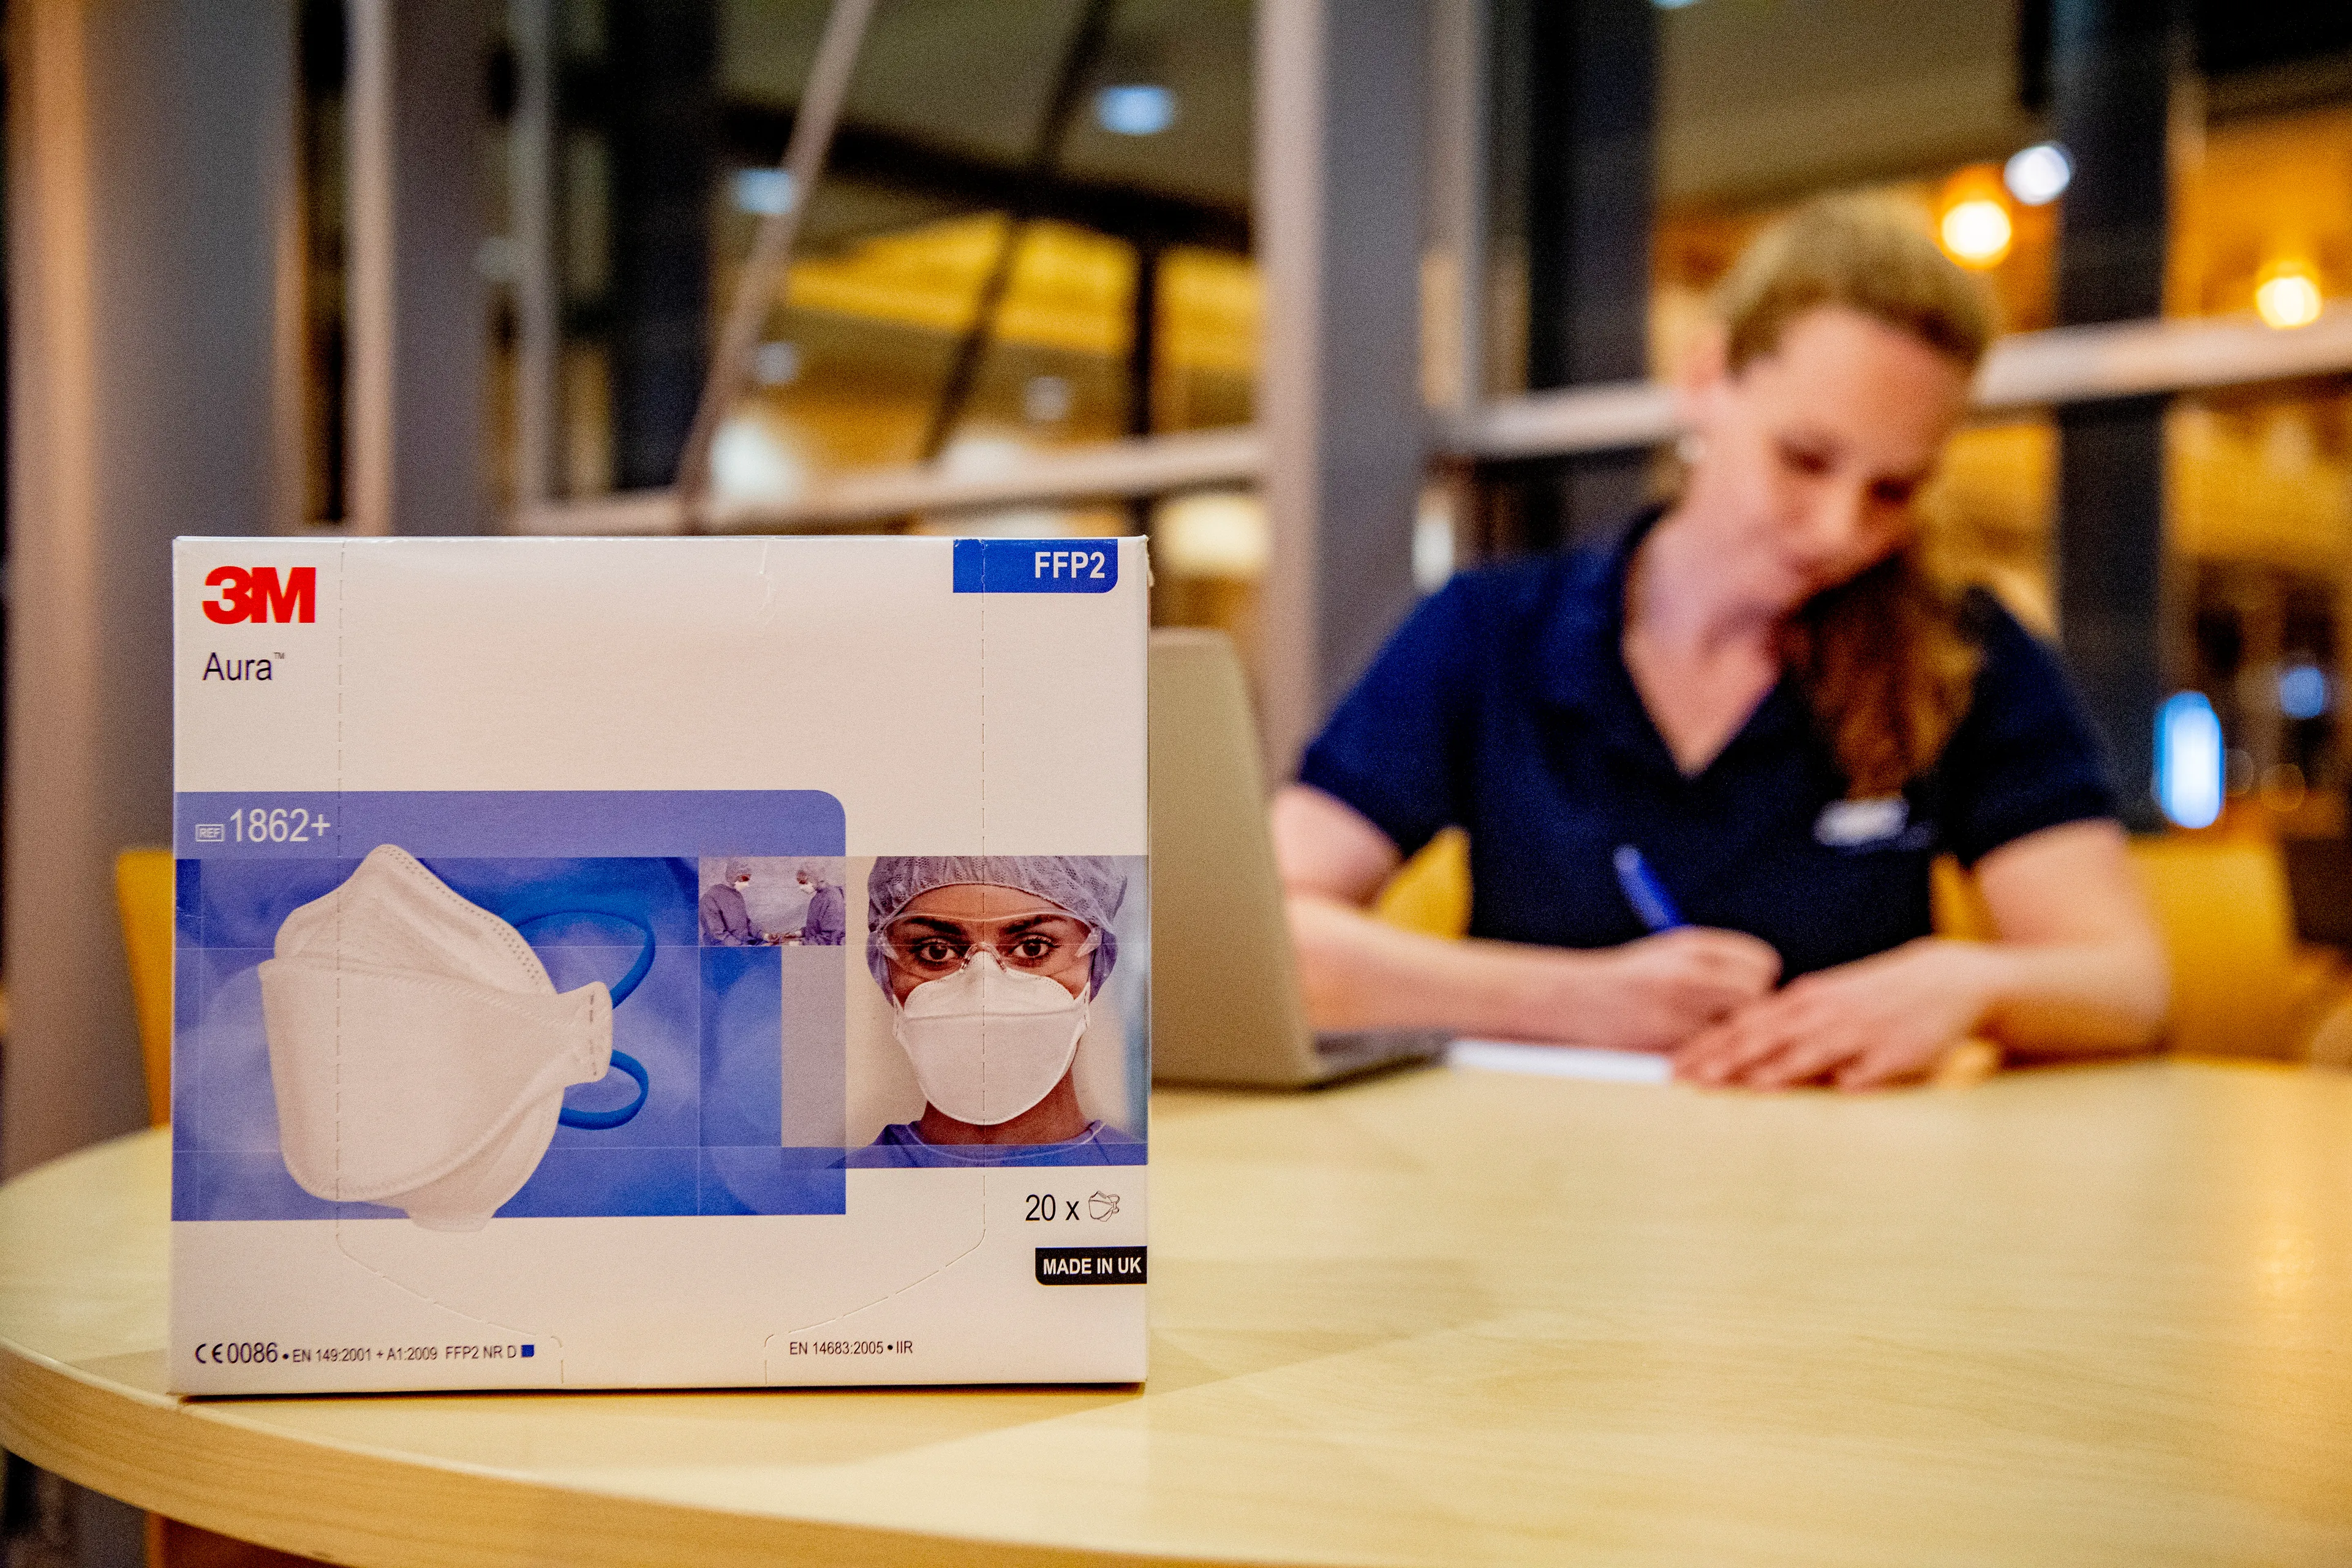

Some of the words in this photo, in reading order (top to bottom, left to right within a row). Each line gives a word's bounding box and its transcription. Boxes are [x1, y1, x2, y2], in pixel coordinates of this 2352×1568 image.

[1035, 552, 1106, 579] FFP2
[202, 565, 316, 624] 3M
[199, 827, 221, 838] REF
[230, 808, 331, 842] 1862+
[1025, 1194, 1056, 1221] 20
[1065, 1200, 1080, 1221] x
[1043, 1257, 1092, 1275] MADE
[1096, 1257, 1113, 1274] IN
[1118, 1257, 1142, 1274] UK
[292, 1349, 311, 1362] EN
[315, 1348, 371, 1362] 149:2001
[386, 1347, 438, 1360] A1:2009
[445, 1346, 479, 1359] FFP2
[483, 1345, 503, 1359] NR
[507, 1345, 517, 1358] D
[790, 1341, 808, 1355] EN
[813, 1341, 883, 1355] 14683:2005
